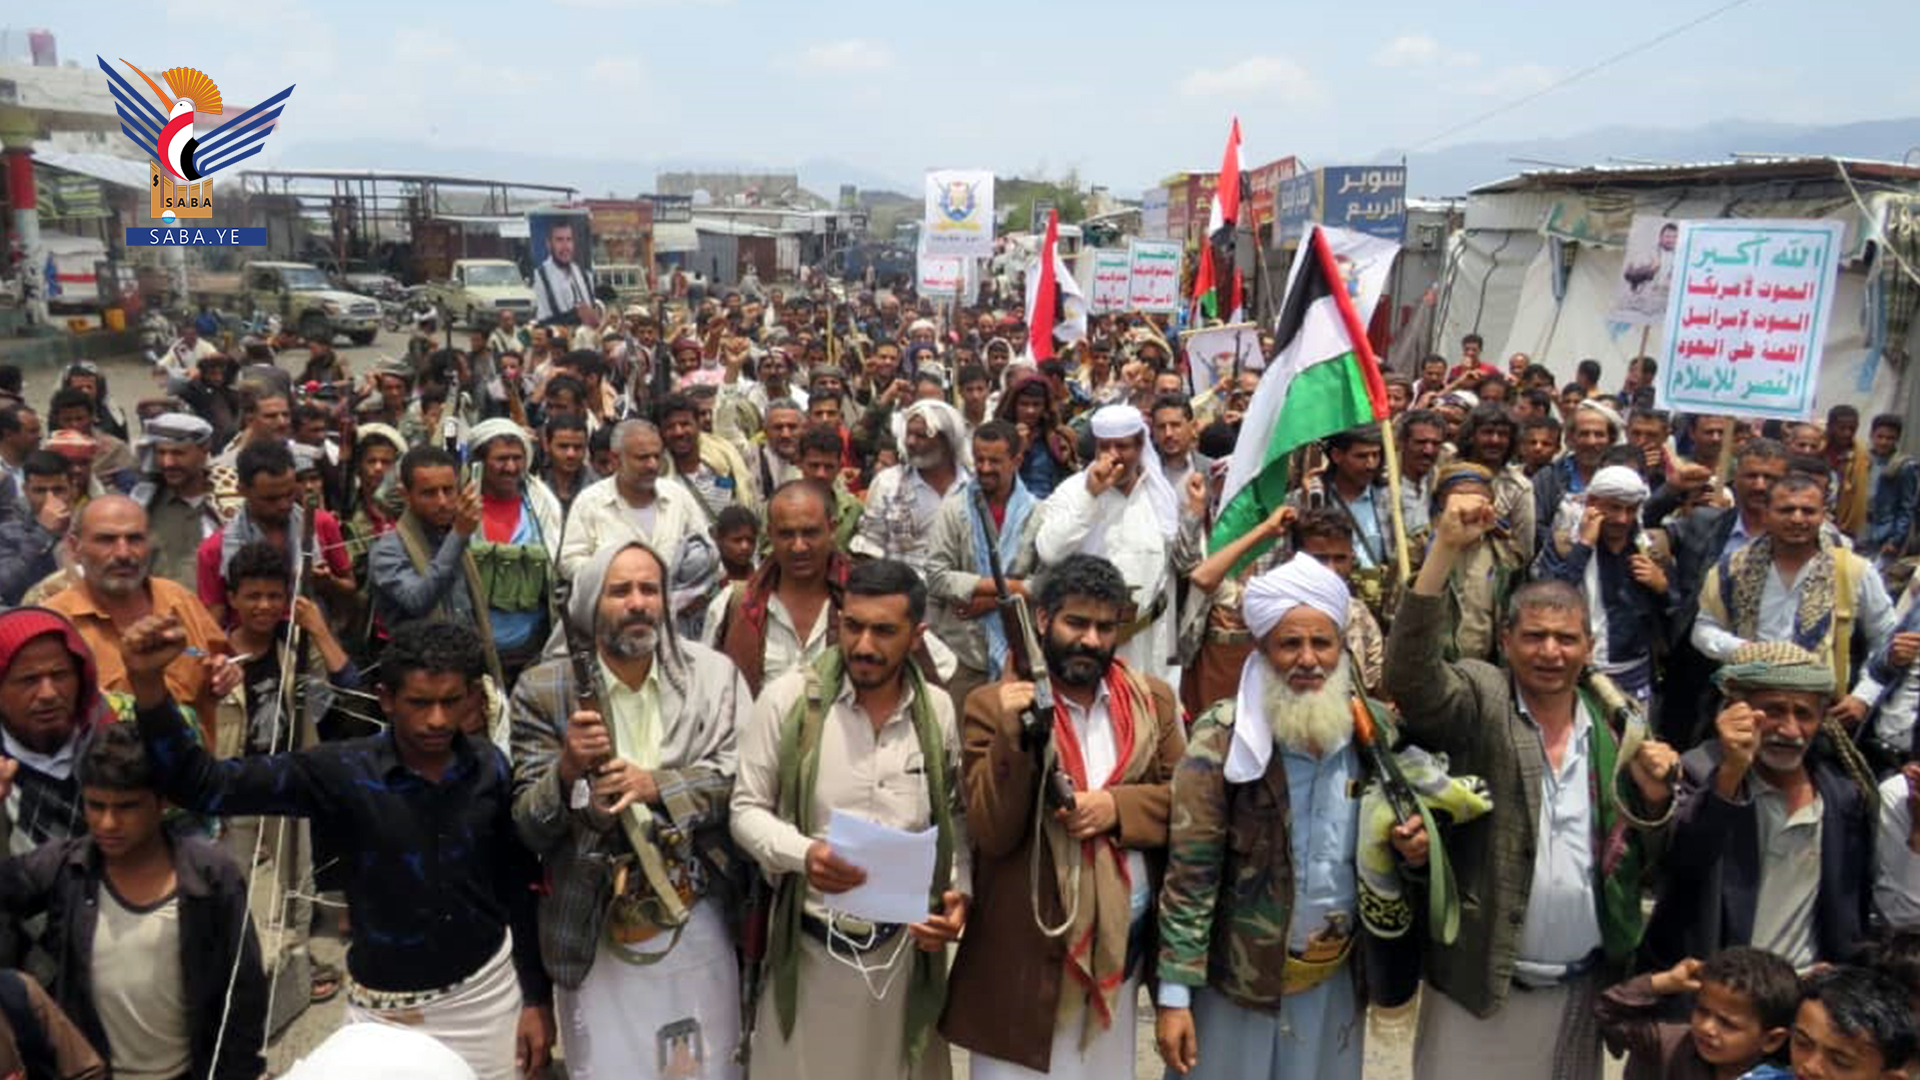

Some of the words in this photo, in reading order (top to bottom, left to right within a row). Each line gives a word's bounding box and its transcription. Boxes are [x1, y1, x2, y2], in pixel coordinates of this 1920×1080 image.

[1338, 170, 1404, 194] سوبر
[1345, 197, 1402, 222] الربيع
[1771, 238, 1820, 267] الله
[1758, 281, 1814, 302] الموت
[1753, 311, 1810, 333] الموت
[1677, 339, 1724, 359] اليهود
[1728, 342, 1754, 362] على
[1761, 341, 1805, 362] اللعنة
[1739, 368, 1800, 398] النصر
